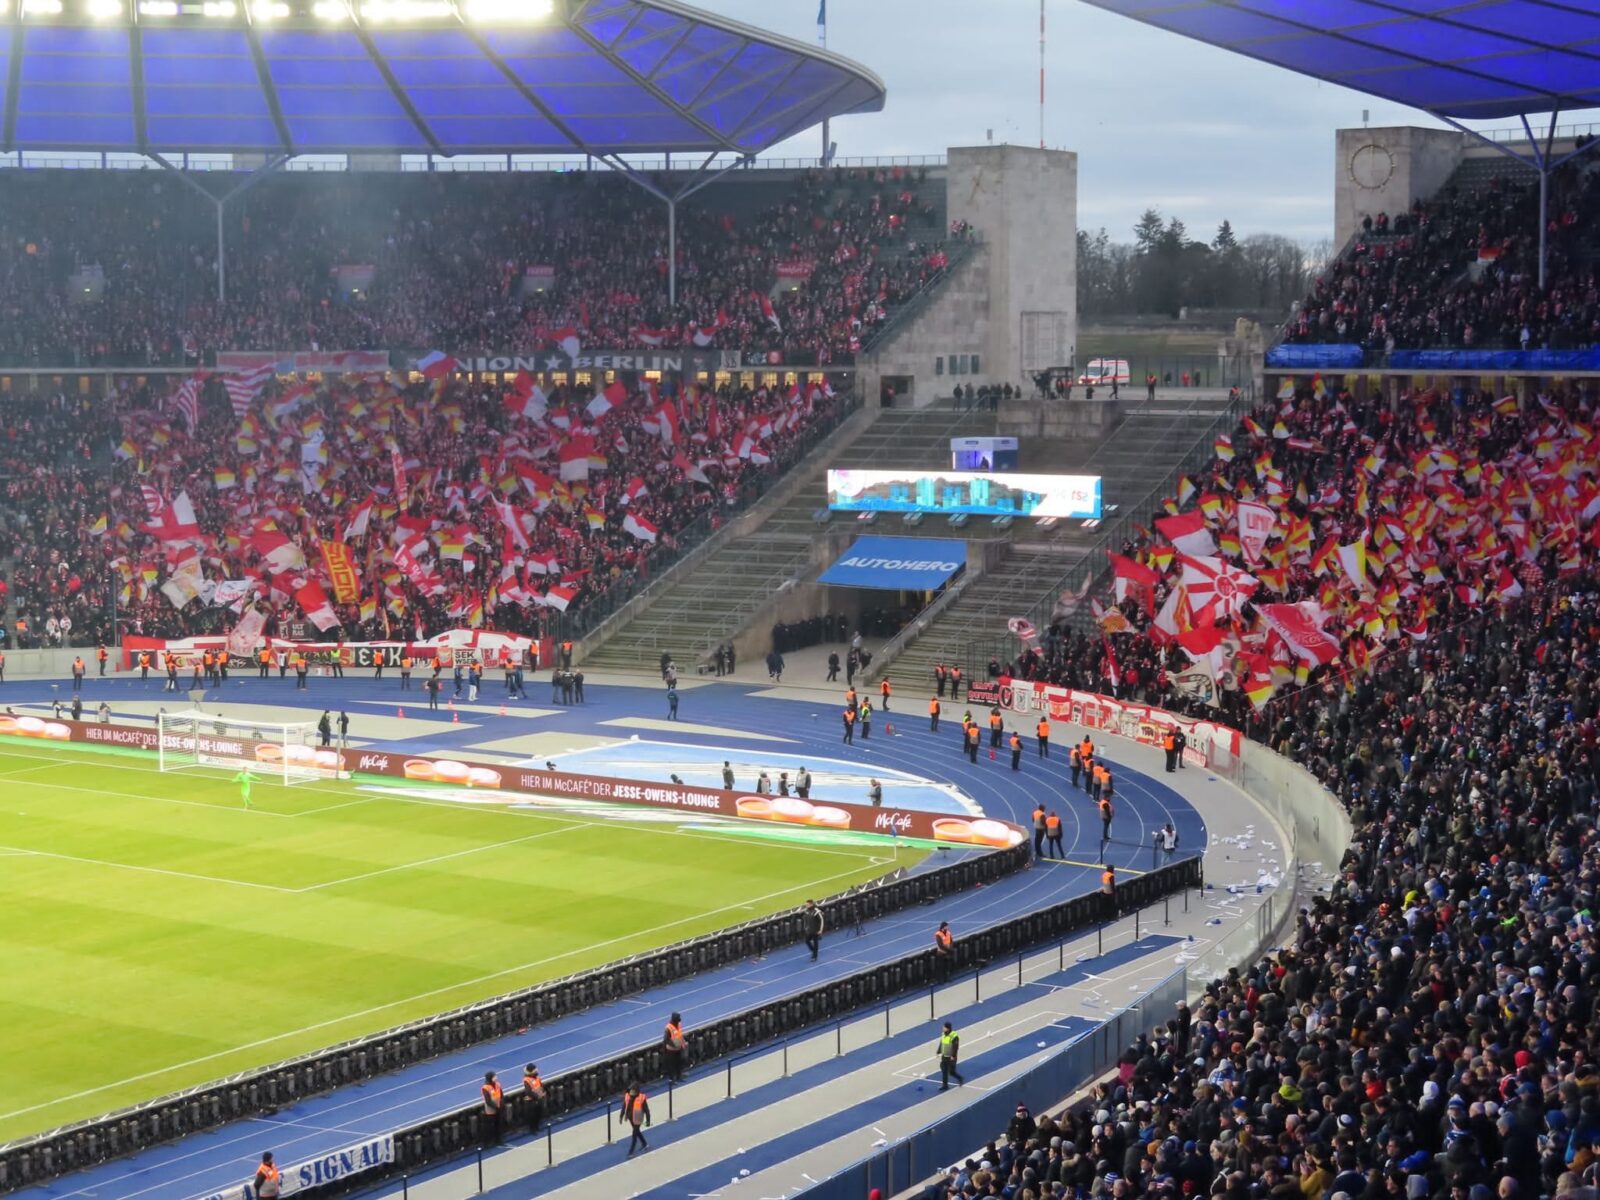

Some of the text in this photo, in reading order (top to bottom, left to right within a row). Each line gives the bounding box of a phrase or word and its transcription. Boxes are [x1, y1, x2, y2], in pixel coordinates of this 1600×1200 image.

[453, 355, 682, 371] NION BERLIN
[839, 556, 959, 573] AUTOHERO
[454, 651, 475, 659] SEK
[86, 728, 102, 739] HIER
[104, 730, 112, 740] IM
[143, 735, 157, 745] DER
[521, 775, 541, 787] HIER
[542, 777, 552, 788] IM
[593, 784, 611, 796] DER
[613, 785, 720, 808] JESSE-OWENS-LOUNGE
[299, 1138, 391, 1187] SIGNAL!
